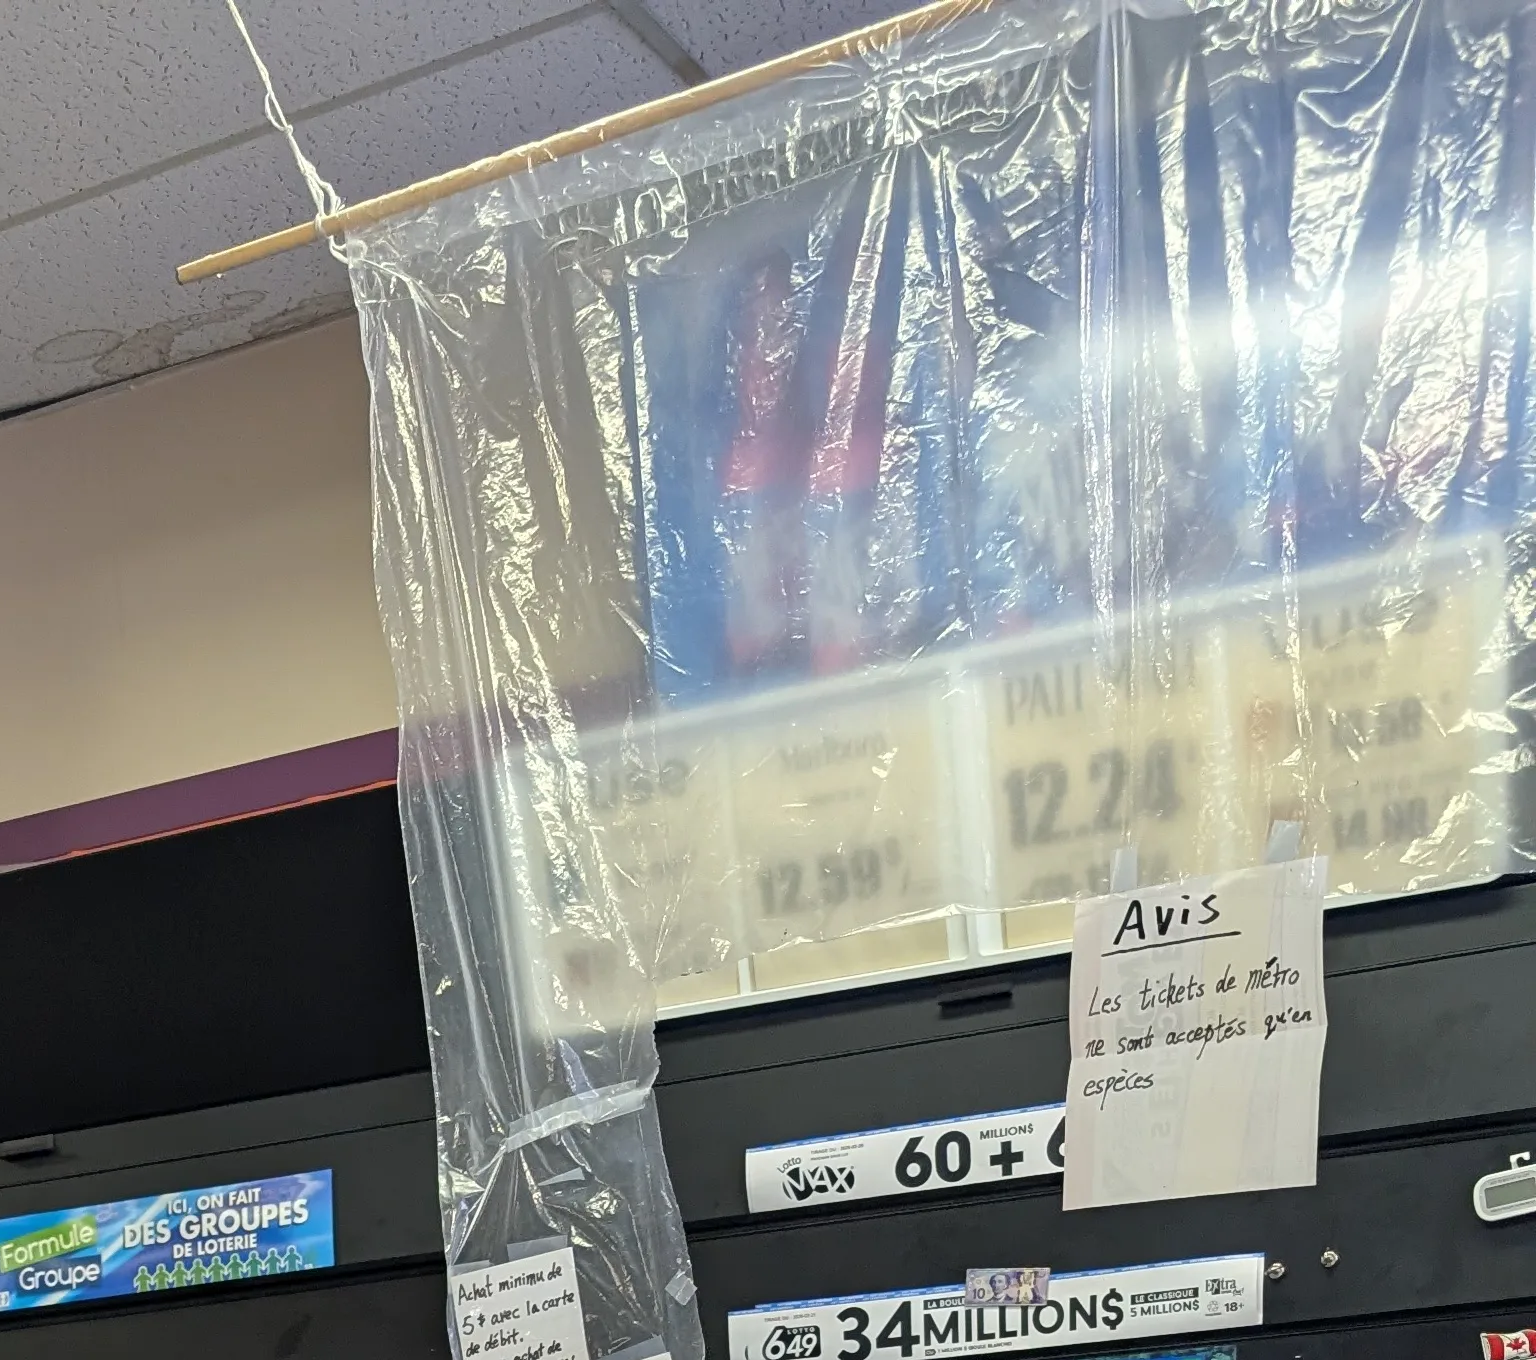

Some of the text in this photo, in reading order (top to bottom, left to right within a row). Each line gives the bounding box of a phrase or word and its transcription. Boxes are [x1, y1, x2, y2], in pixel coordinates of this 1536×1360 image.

[1113, 894, 1220, 945] Avis
[1088, 957, 1300, 1017] Les tickets de métro
[1084, 1007, 1312, 1060] ne sont acceptés qu'en
[1083, 1069, 1154, 1110] espèces
[980, 1123, 1034, 1140] MILLION$
[895, 1131, 971, 1188] 60
[166, 1188, 261, 1216] ICI, ON FAIT
[123, 1199, 309, 1248] DES GROUPES
[1, 1224, 93, 1267] Formule
[173, 1233, 257, 1258] DE LOTERIE
[19, 1262, 101, 1291] Groupe
[458, 1262, 562, 1305] Achat de
[491, 1290, 574, 1325] avec carte
[973, 1288, 985, 1299] 10
[1131, 1300, 1200, 1317] 5 MILLION$
[1147, 1289, 1194, 1302] CLASSIQUE
[787, 1326, 814, 1335] LOTTO
[924, 1288, 1123, 1346] MILLION$
[466, 1329, 523, 1357] de débit.
[548, 1340, 561, 1355] de
